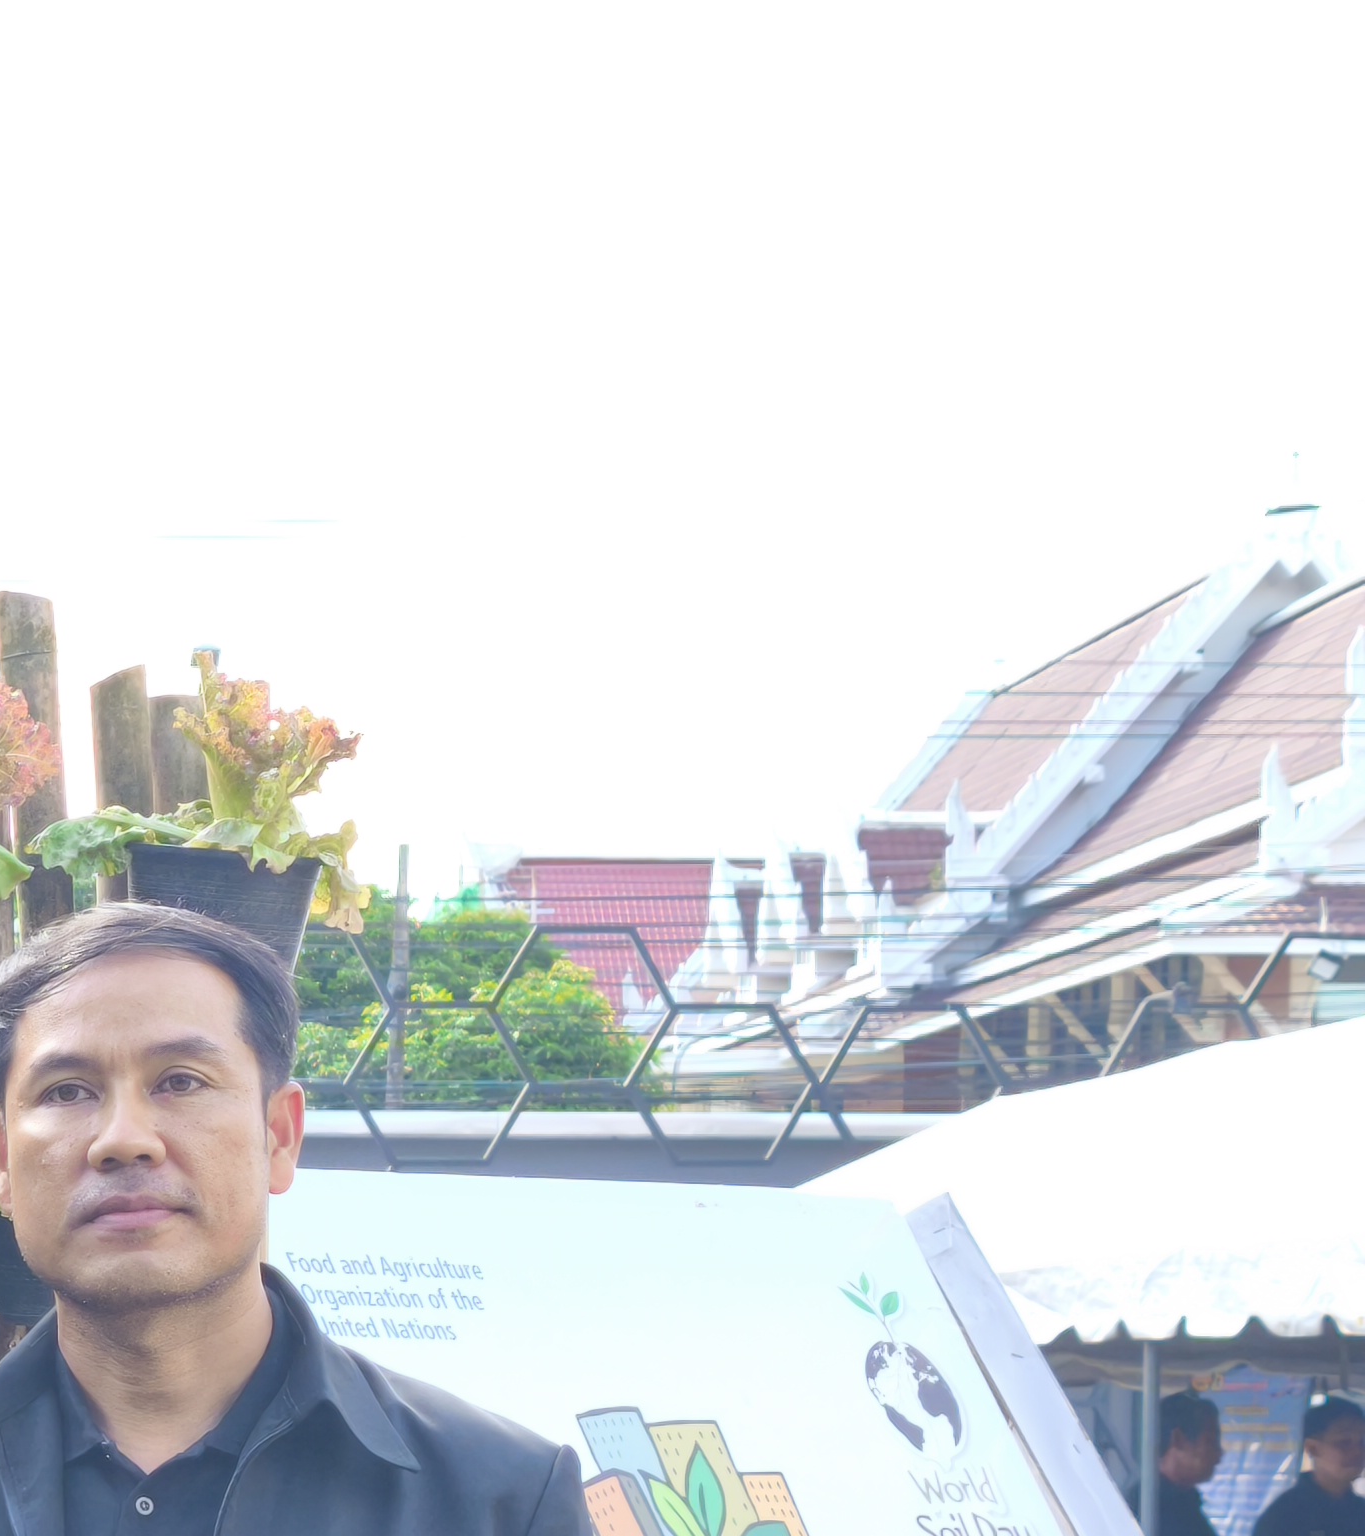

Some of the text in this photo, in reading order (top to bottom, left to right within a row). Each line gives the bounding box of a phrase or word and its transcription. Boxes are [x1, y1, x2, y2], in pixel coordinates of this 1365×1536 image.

[286, 1252, 484, 1283] Food and Agriculture
[300, 1283, 485, 1311] Organization of the
[381, 1317, 457, 1341] Nations
[907, 1466, 999, 1505] World
